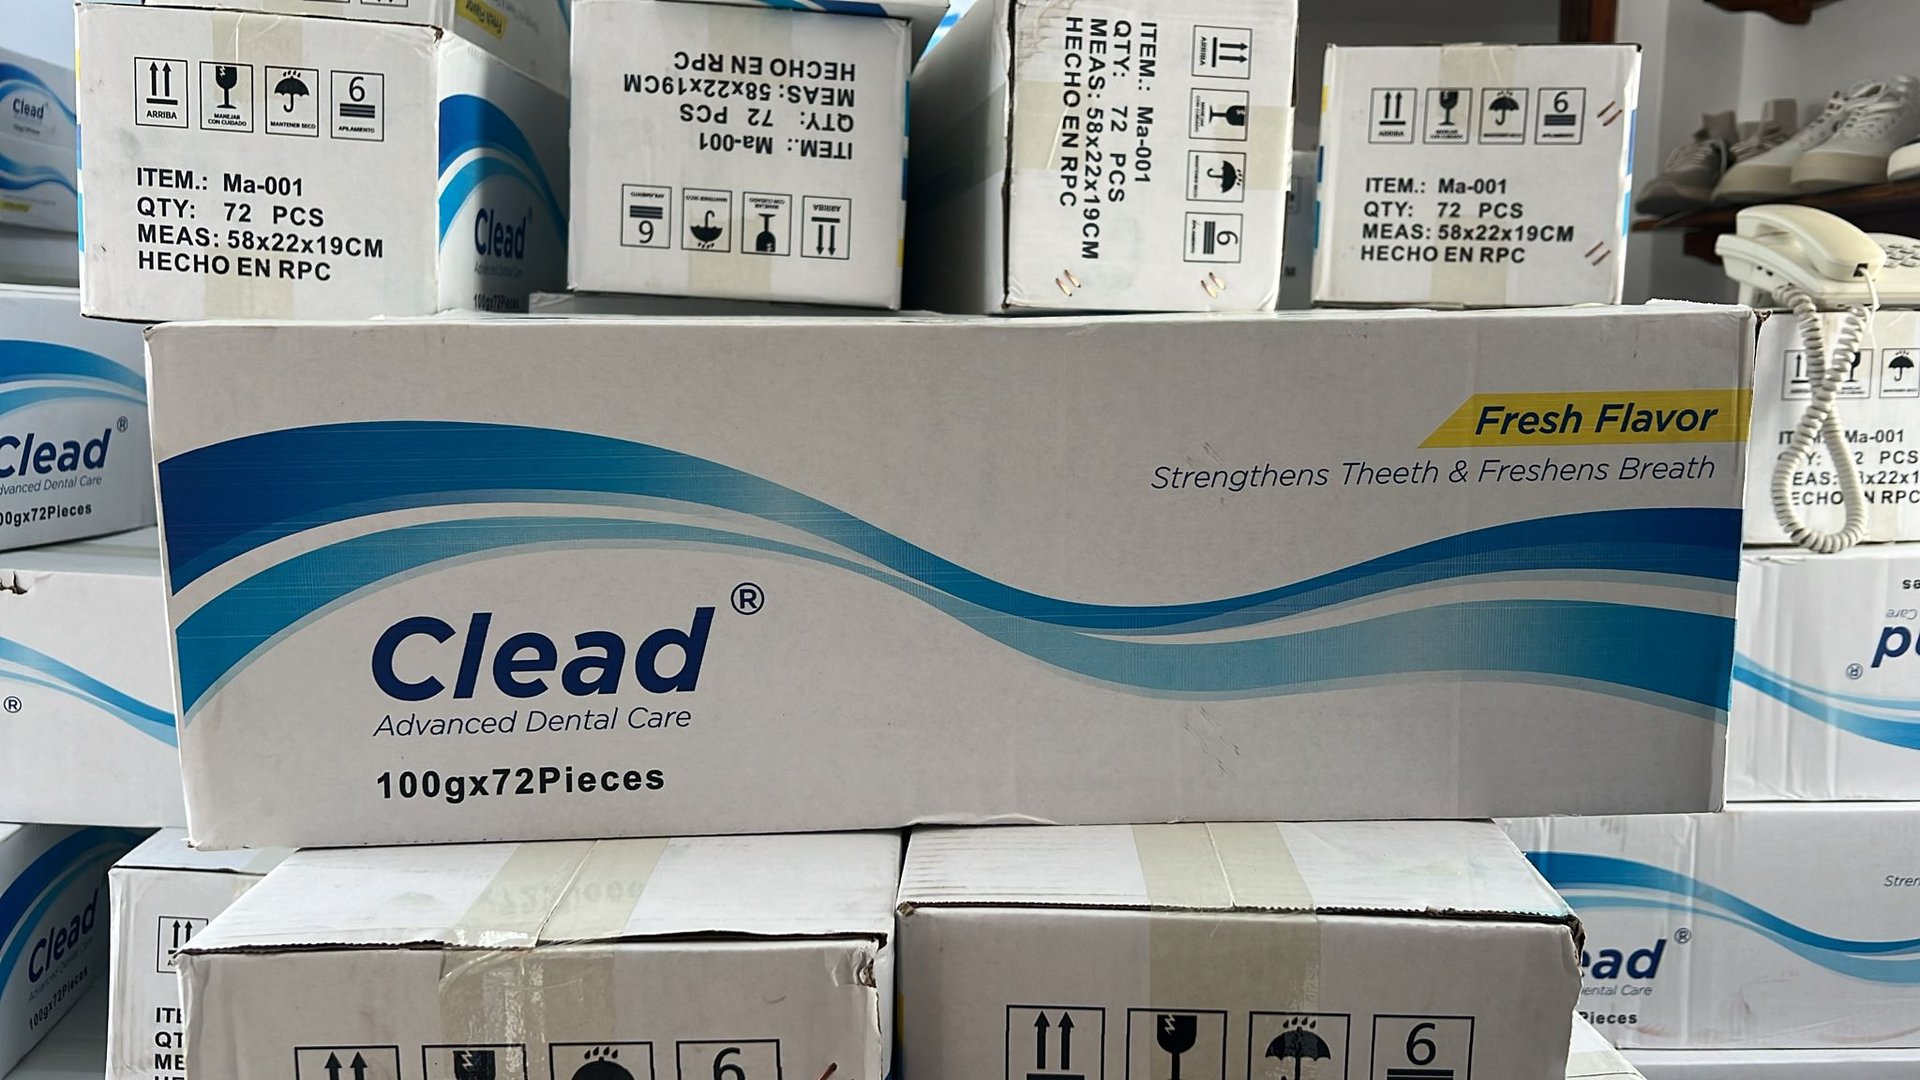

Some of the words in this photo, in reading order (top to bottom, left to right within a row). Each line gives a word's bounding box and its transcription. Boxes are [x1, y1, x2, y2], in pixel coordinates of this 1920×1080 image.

[1088, 19, 1107, 98] MEAS:
[1113, 20, 1131, 77] QTY:
[1139, 22, 1157, 91] ITEM.:
[675, 52, 723, 72] RPC
[732, 56, 762, 75] EN
[770, 58, 855, 81] HECHO
[1063, 17, 1083, 107] HECHO
[349, 76, 365, 102] 6
[624, 72, 771, 101] 58x22x19CM
[780, 84, 854, 107] MEAS:
[12, 98, 45, 119] Clead
[146, 110, 178, 120] ARRIBA
[680, 104, 727, 124] PCS
[1554, 91, 1568, 113] 6
[748, 108, 773, 127] 72
[801, 112, 854, 132] QTY:
[1111, 106, 1128, 132] 72
[700, 133, 772, 154] Ma-001
[1062, 116, 1079, 148] EN
[1135, 107, 1153, 182] Ma-001
[788, 139, 852, 160] ITEM.:
[138, 167, 207, 190] ITEM.:
[224, 173, 301, 196] Ma-001
[1060, 156, 1078, 206] RPC
[1082, 107, 1103, 259] 58x22x19CM
[1108, 153, 1126, 202] PCS
[1366, 177, 1425, 193] ITEM.:
[1438, 178, 1506, 194] Ma-001
[138, 197, 194, 218] QTY:
[224, 203, 251, 222] 72
[273, 206, 323, 227] PCS
[1364, 201, 1413, 217] QTY:
[1438, 202, 1461, 218] 72
[1479, 202, 1523, 219] PCS
[138, 224, 218, 247] MEAS:
[228, 230, 382, 259] 58x22x19CM
[474, 208, 526, 260] Clead
[639, 220, 654, 243] 6
[1217, 231, 1238, 245] 6
[1363, 223, 1430, 239] MEAS:
[1438, 224, 1574, 242] 58x22x19CM
[139, 251, 229, 274] HECHO
[238, 257, 270, 277] EN
[279, 260, 330, 281] RPC
[1361, 245, 1438, 262] HECHO
[1445, 246, 1473, 262] EN
[1480, 247, 1525, 263] RPC
[1475, 404, 1582, 435] Fresh
[1595, 403, 1718, 433] Flavor
[1843, 427, 1905, 444] Ma-001
[0, 426, 114, 480] Clead
[1879, 450, 1919, 465] PCS
[43, 475, 78, 492] Dental
[79, 474, 103, 488] Care
[1151, 464, 1329, 491] Strengthens
[1343, 460, 1438, 485] Theeth
[1449, 460, 1468, 483] &
[1478, 458, 1609, 482] Freshens
[1619, 455, 1714, 480] Breath
[1792, 471, 1840, 486] EAS:
[1880, 489, 1920, 505] RPC
[371, 606, 716, 702] Clead
[373, 711, 517, 736] Advanced
[526, 707, 618, 732] Dental
[628, 707, 691, 728] Care
[378, 766, 664, 804] 100gx72Pieces
[28, 887, 99, 983] Clead
[1620, 984, 1653, 996] Care
[1406, 1023, 1436, 1065] 6
